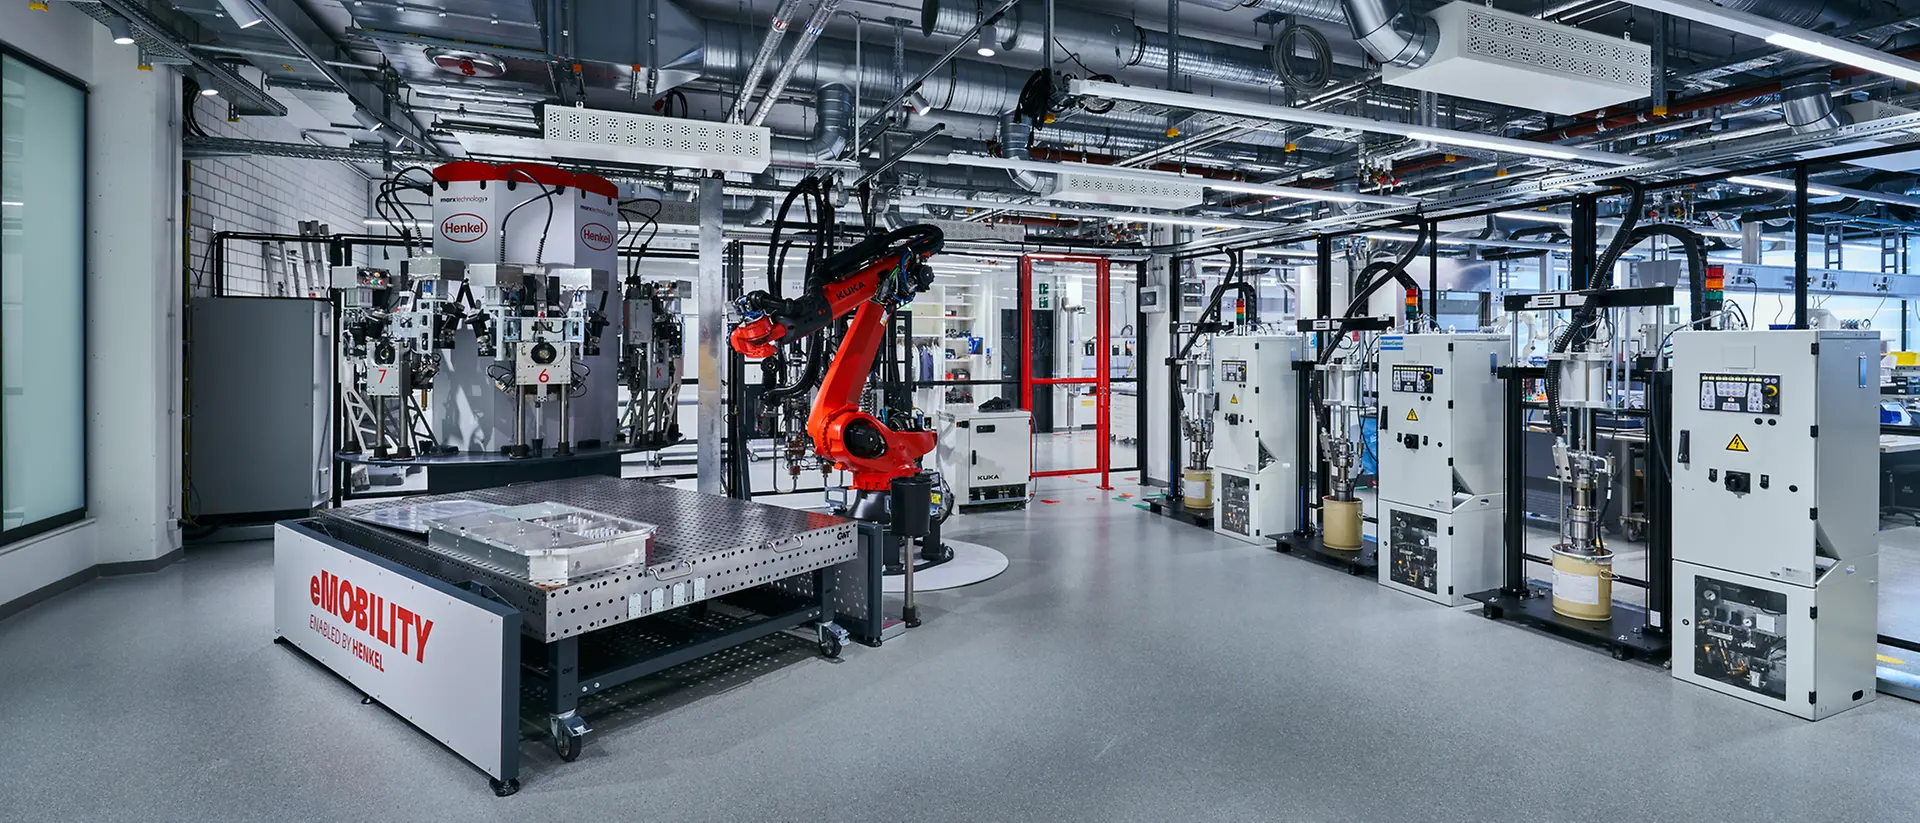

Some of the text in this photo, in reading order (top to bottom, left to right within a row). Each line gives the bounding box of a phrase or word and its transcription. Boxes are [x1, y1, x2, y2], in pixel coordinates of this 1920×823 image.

[445, 222, 484, 233] Henkel
[583, 229, 611, 244] Henkel
[835, 281, 866, 300] KUKA
[378, 369, 387, 384] 7
[538, 368, 550, 383] 6
[310, 569, 434, 664] eMOBILITY
[309, 614, 385, 673] ENABLED BY HENKEL
